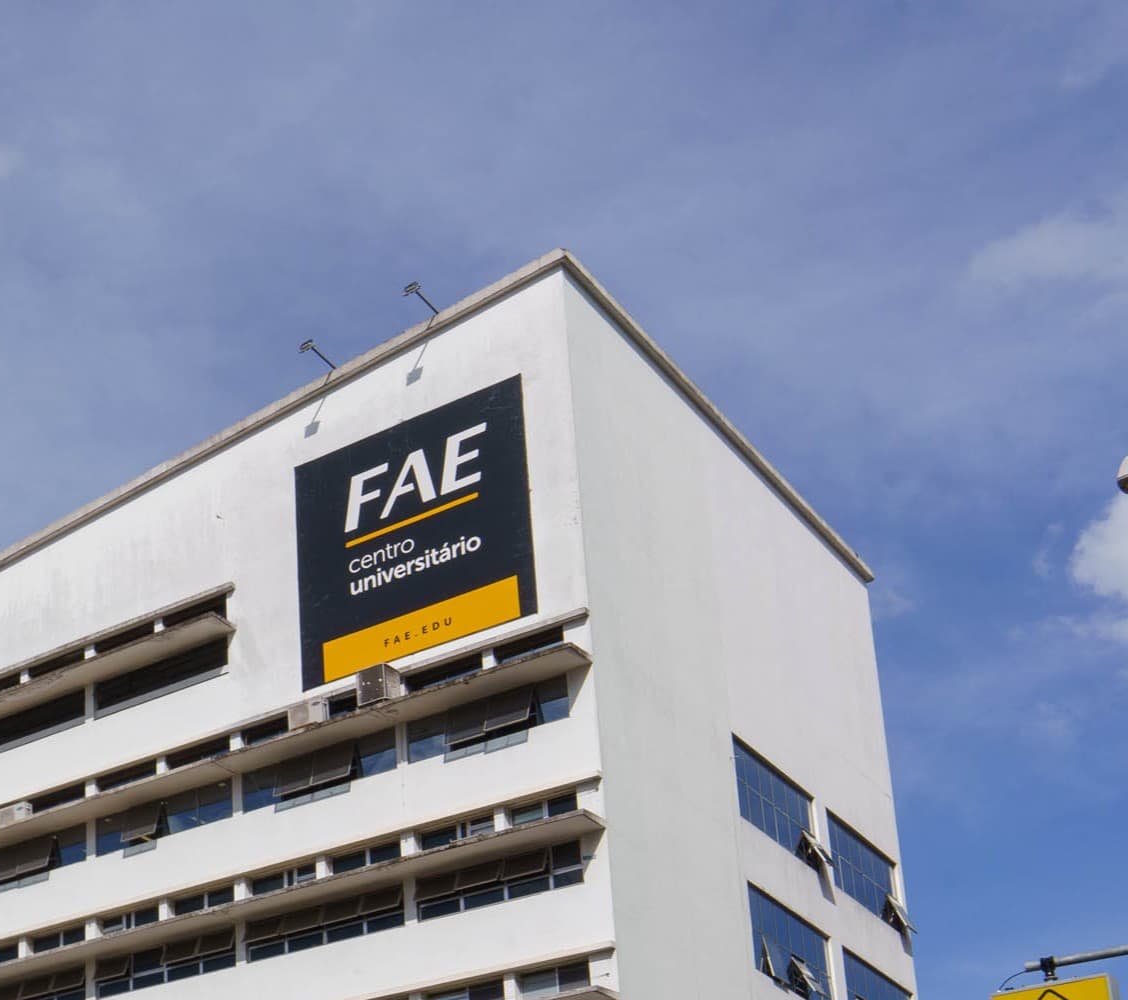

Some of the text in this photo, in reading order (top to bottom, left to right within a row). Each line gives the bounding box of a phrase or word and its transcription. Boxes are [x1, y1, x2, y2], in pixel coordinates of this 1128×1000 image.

[344, 422, 487, 533] FAE
[348, 538, 415, 573] centro
[349, 535, 482, 596] universitário
[383, 616, 453, 648] FAE.EDU
